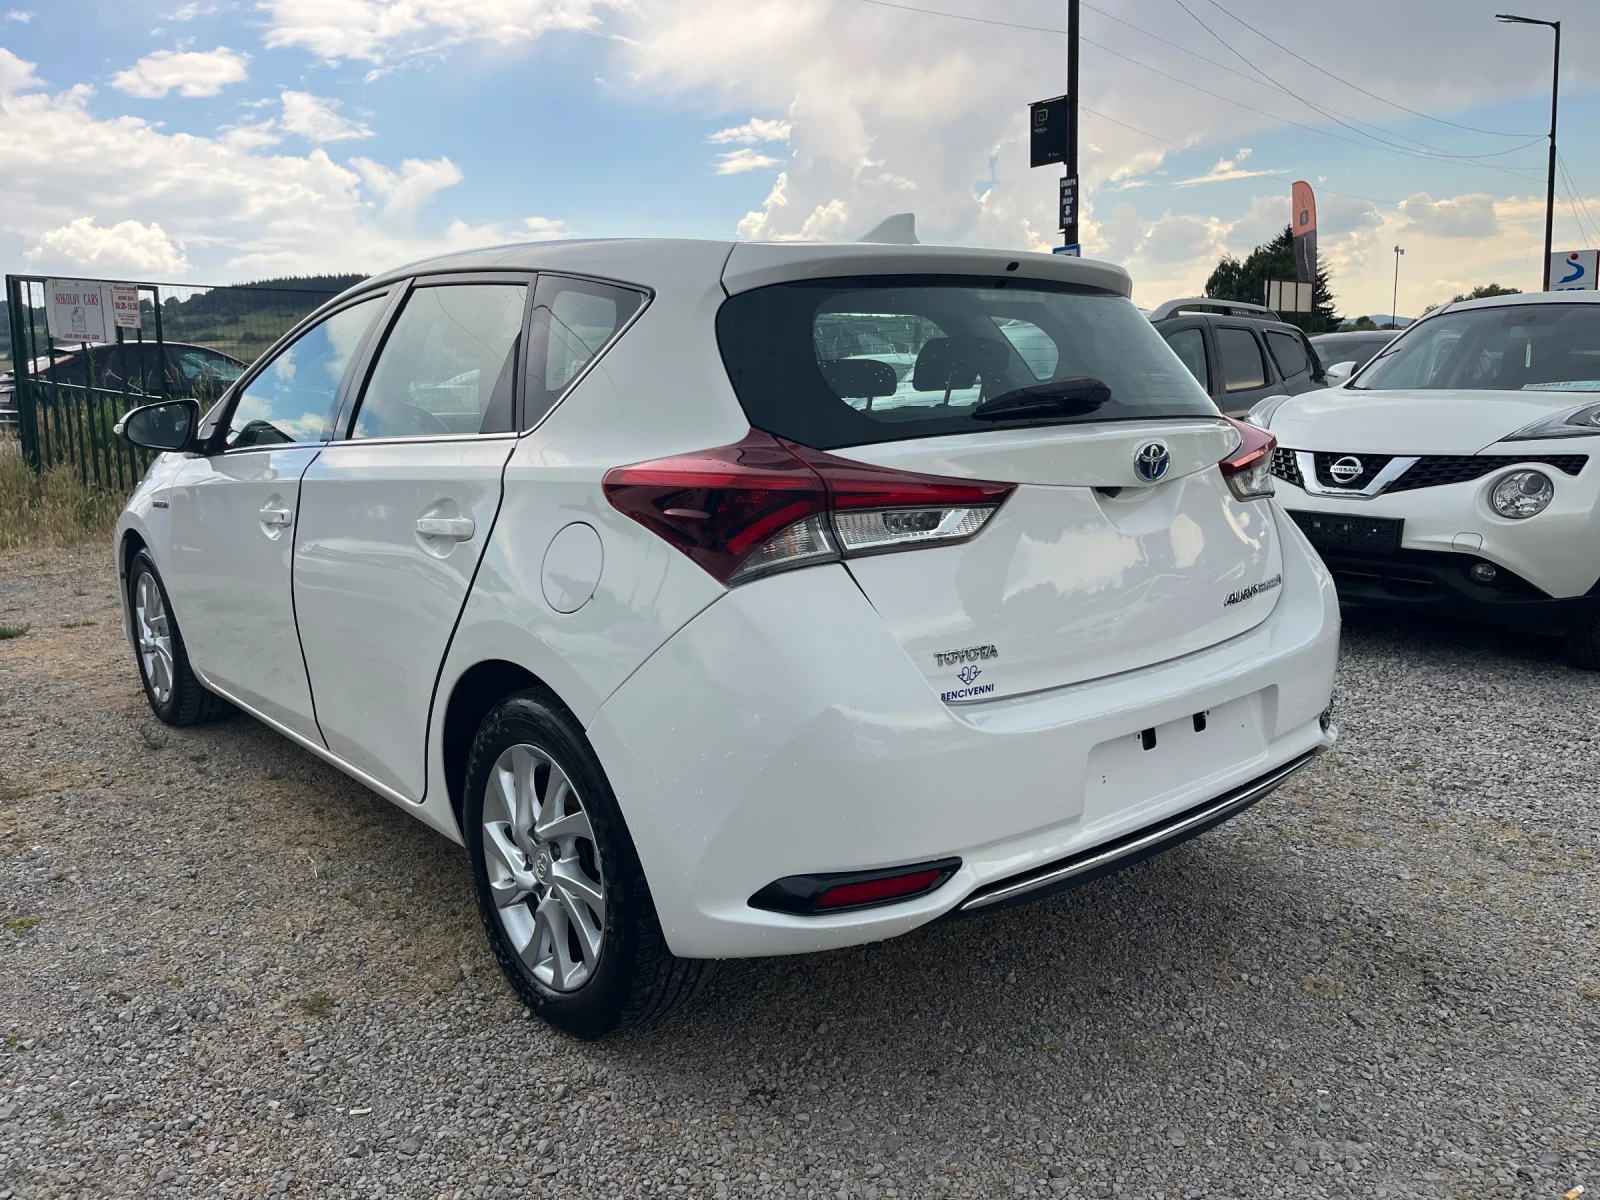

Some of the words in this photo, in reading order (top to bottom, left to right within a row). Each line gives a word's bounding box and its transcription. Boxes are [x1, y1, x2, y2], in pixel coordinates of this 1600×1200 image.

[1061, 178, 1076, 188] СКАРА
[55, 293, 80, 305] SOKOLOV
[83, 293, 99, 306] CARS
[934, 644, 998, 667] TOYOTA
[941, 684, 994, 701] BENCIVENNI
